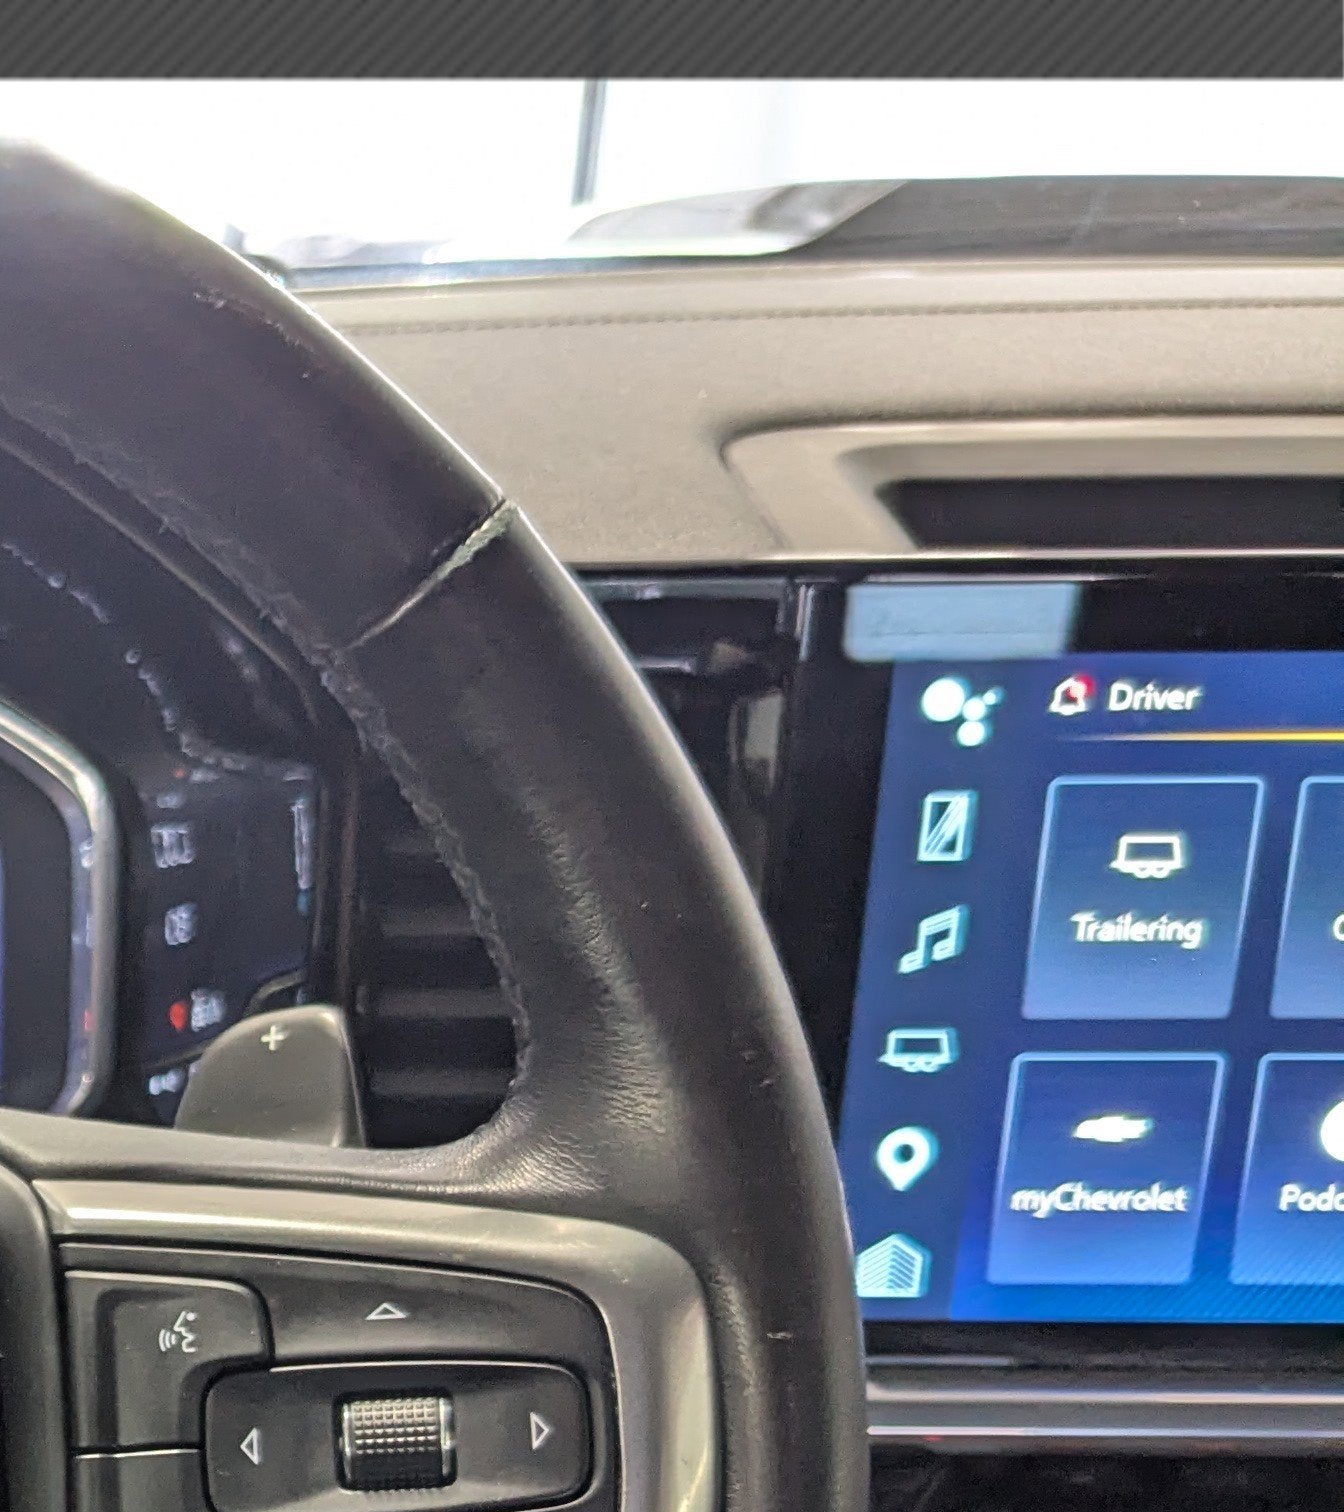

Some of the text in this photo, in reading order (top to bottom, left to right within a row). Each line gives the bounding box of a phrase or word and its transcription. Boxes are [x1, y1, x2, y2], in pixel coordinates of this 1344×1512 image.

[1108, 678, 1203, 711] Driver
[1069, 910, 1207, 949] Trailering
[1010, 1180, 1189, 1219] myChevrolet
